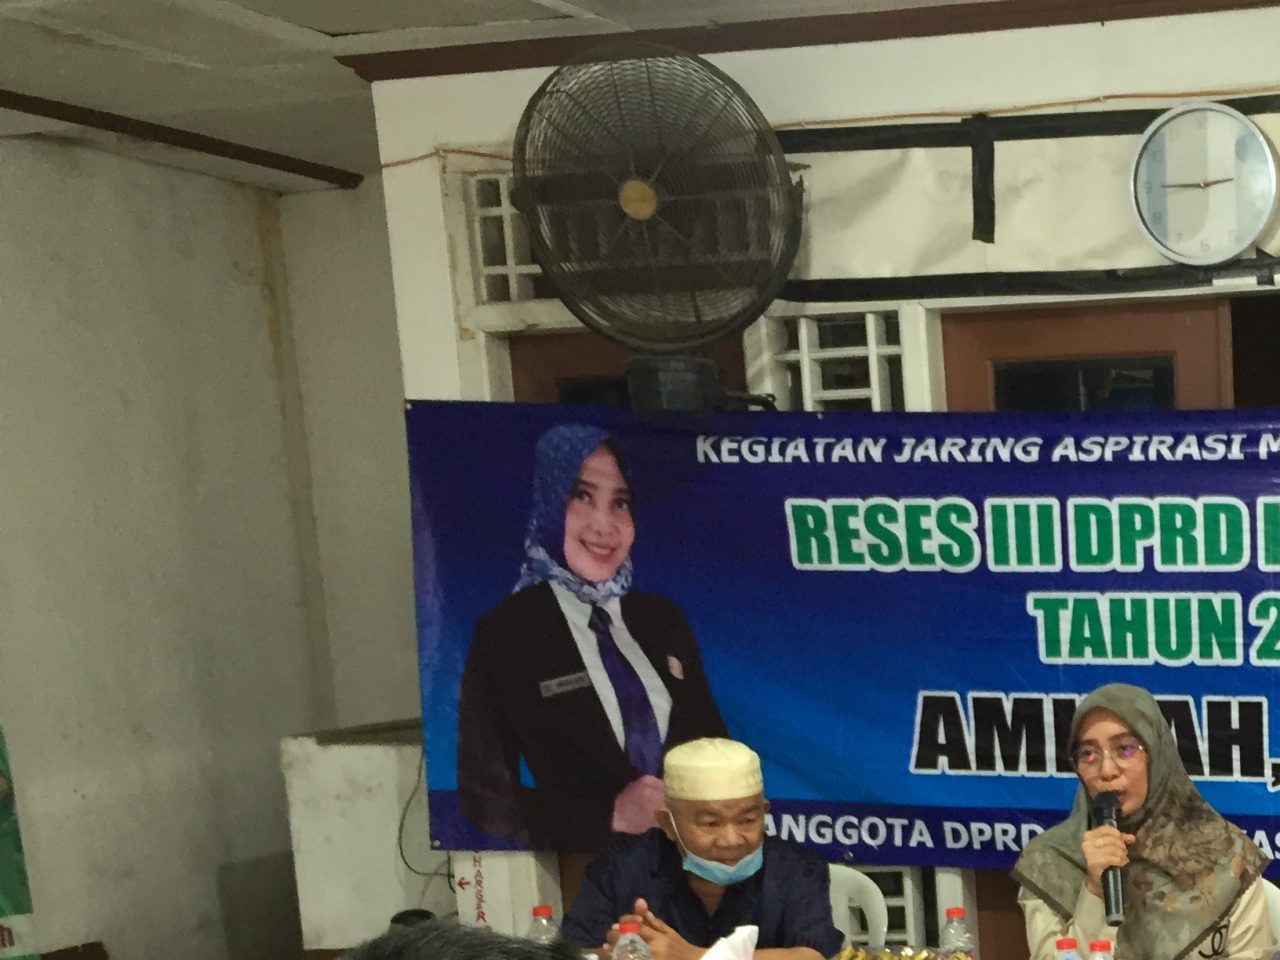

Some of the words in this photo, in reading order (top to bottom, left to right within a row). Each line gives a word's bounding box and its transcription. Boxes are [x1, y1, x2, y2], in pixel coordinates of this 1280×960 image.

[696, 436, 887, 464] KEGIATAN
[897, 437, 1043, 463] JARING
[1051, 433, 1245, 462] ASPIRASI
[784, 497, 980, 573] RESES
[984, 496, 1063, 573] III
[1066, 496, 1252, 574] DPRD
[1026, 591, 1244, 667] TAHUN
